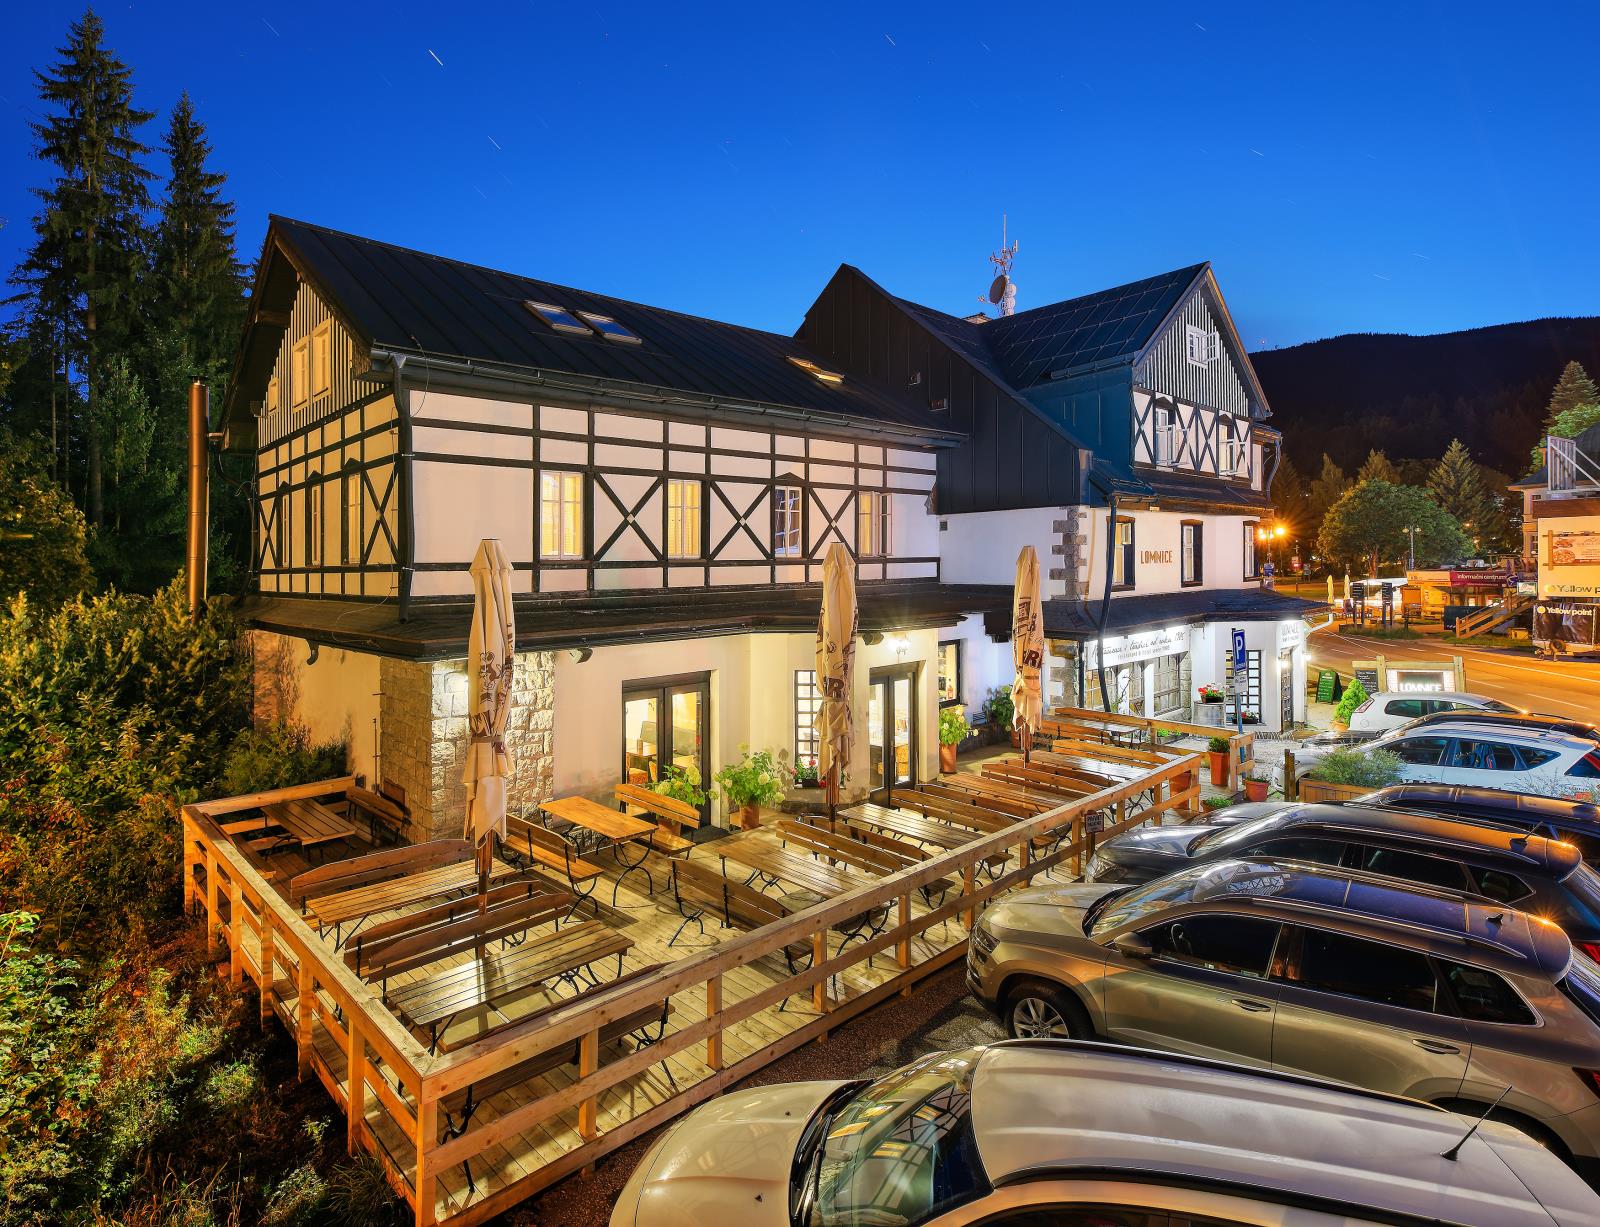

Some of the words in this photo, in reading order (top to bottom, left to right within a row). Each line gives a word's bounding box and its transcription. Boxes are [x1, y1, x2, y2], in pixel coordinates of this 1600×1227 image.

[1140, 550, 1173, 564] LOMNICE
[1557, 585, 1593, 593] Yellow
[1546, 606, 1571, 615] Yellow
[1235, 635, 1243, 660] P
